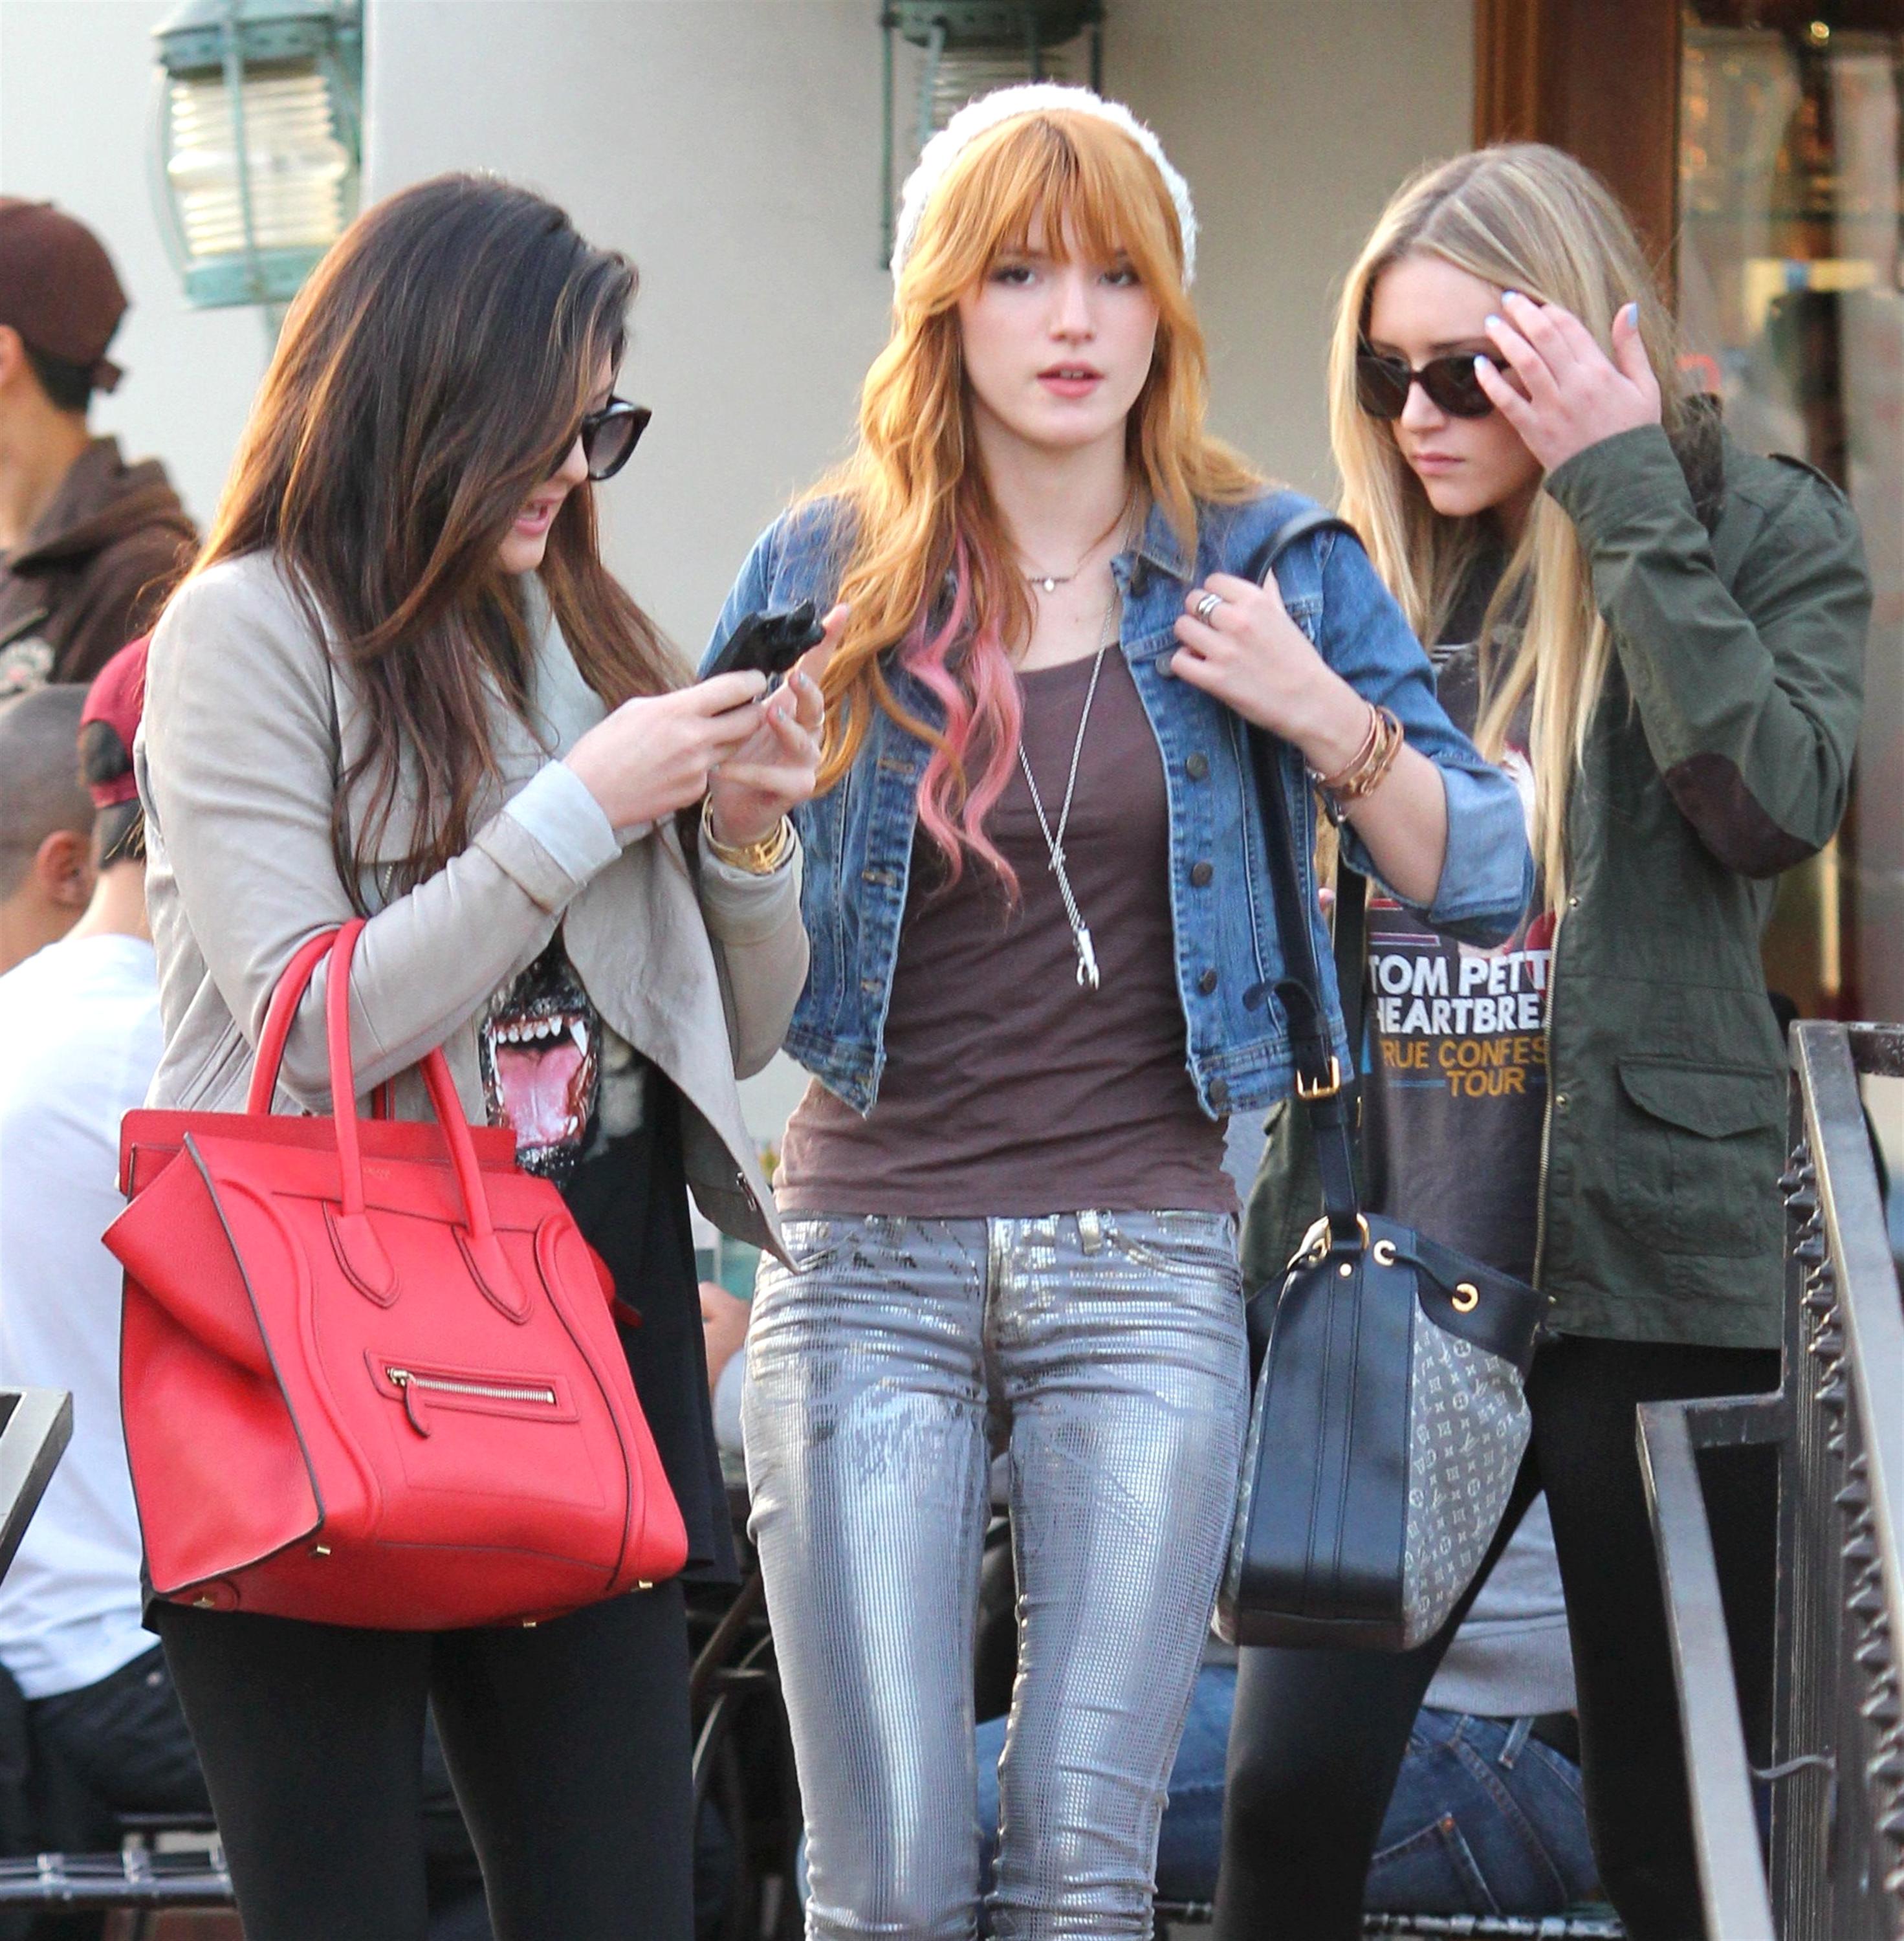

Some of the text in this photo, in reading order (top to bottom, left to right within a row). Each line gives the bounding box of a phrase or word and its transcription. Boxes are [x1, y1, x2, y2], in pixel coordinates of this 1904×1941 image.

[1368, 949, 1549, 996] TOM PETT
[1438, 1035, 1546, 1069] CONFES
[1445, 1067, 1526, 1097] TOUR
